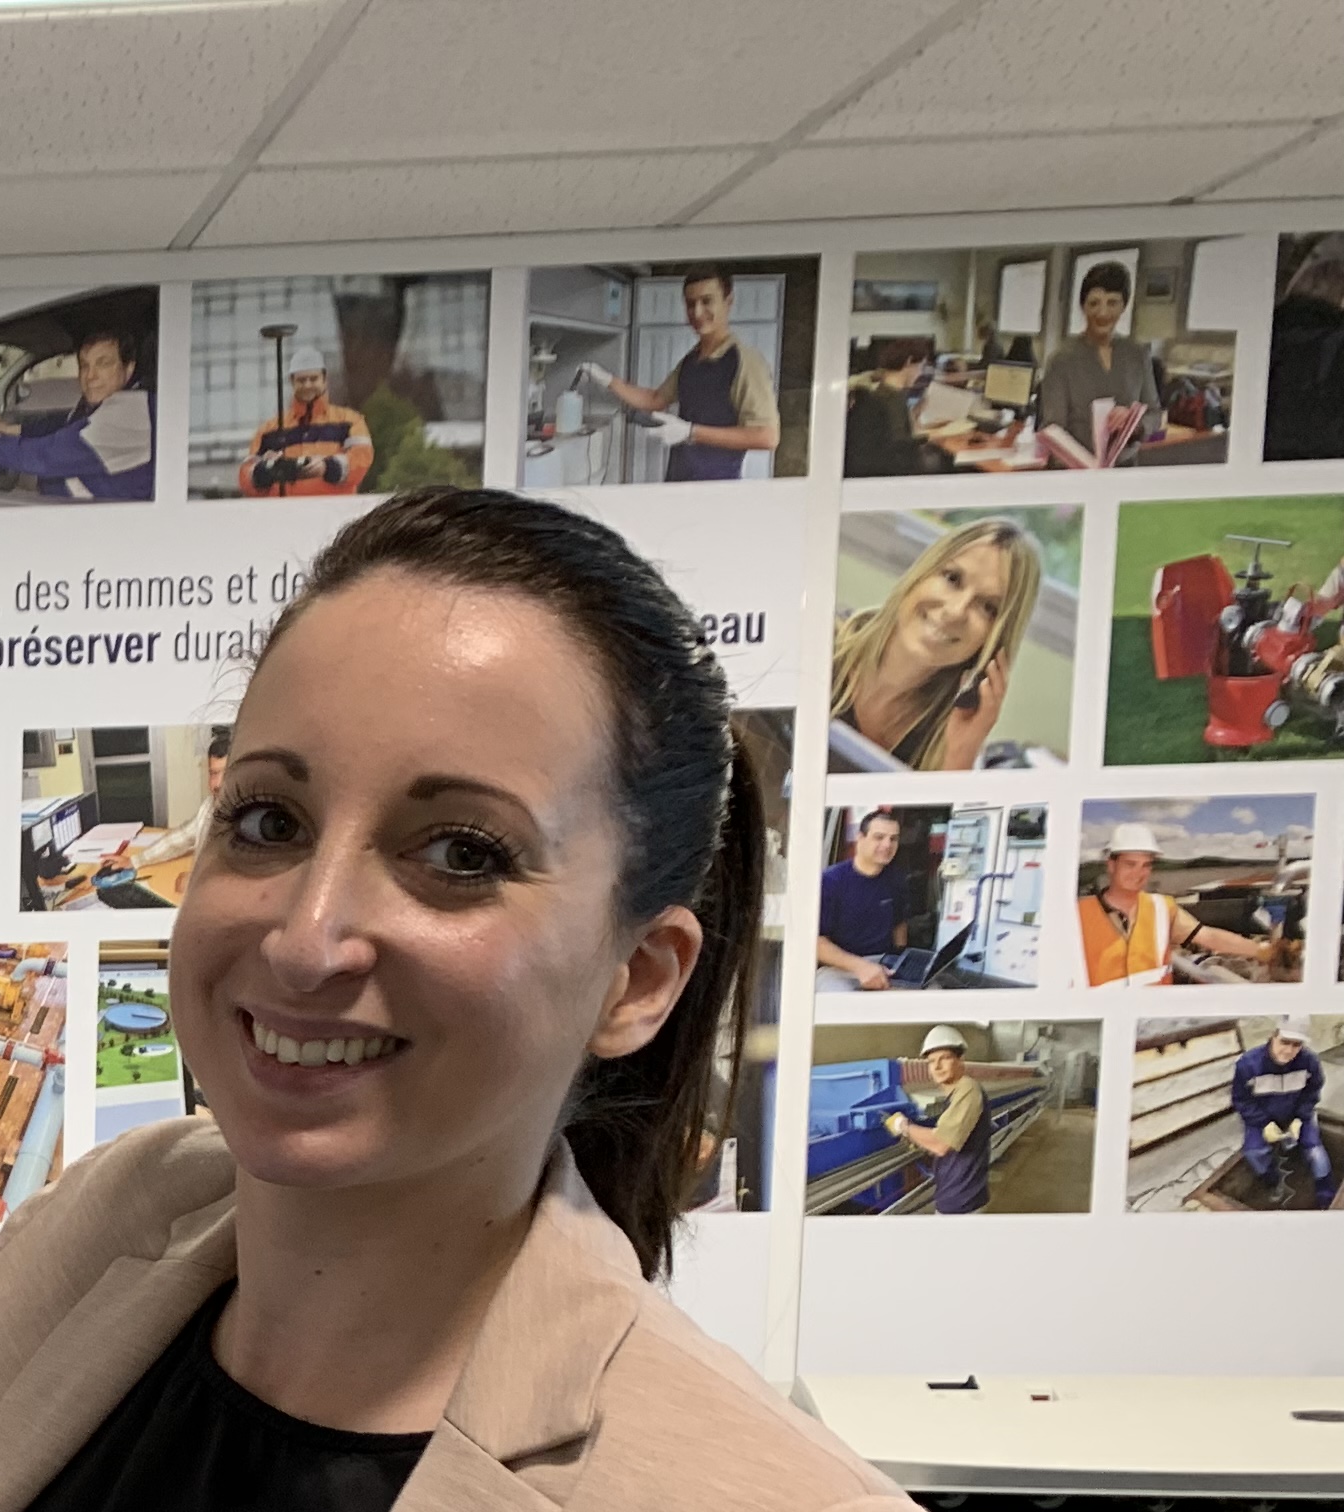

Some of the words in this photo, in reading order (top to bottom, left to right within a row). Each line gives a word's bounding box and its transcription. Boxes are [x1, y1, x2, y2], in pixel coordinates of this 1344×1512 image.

[14, 569, 70, 612] des
[81, 566, 214, 609] femmes
[226, 565, 259, 606] et
[700, 608, 767, 646] eau
